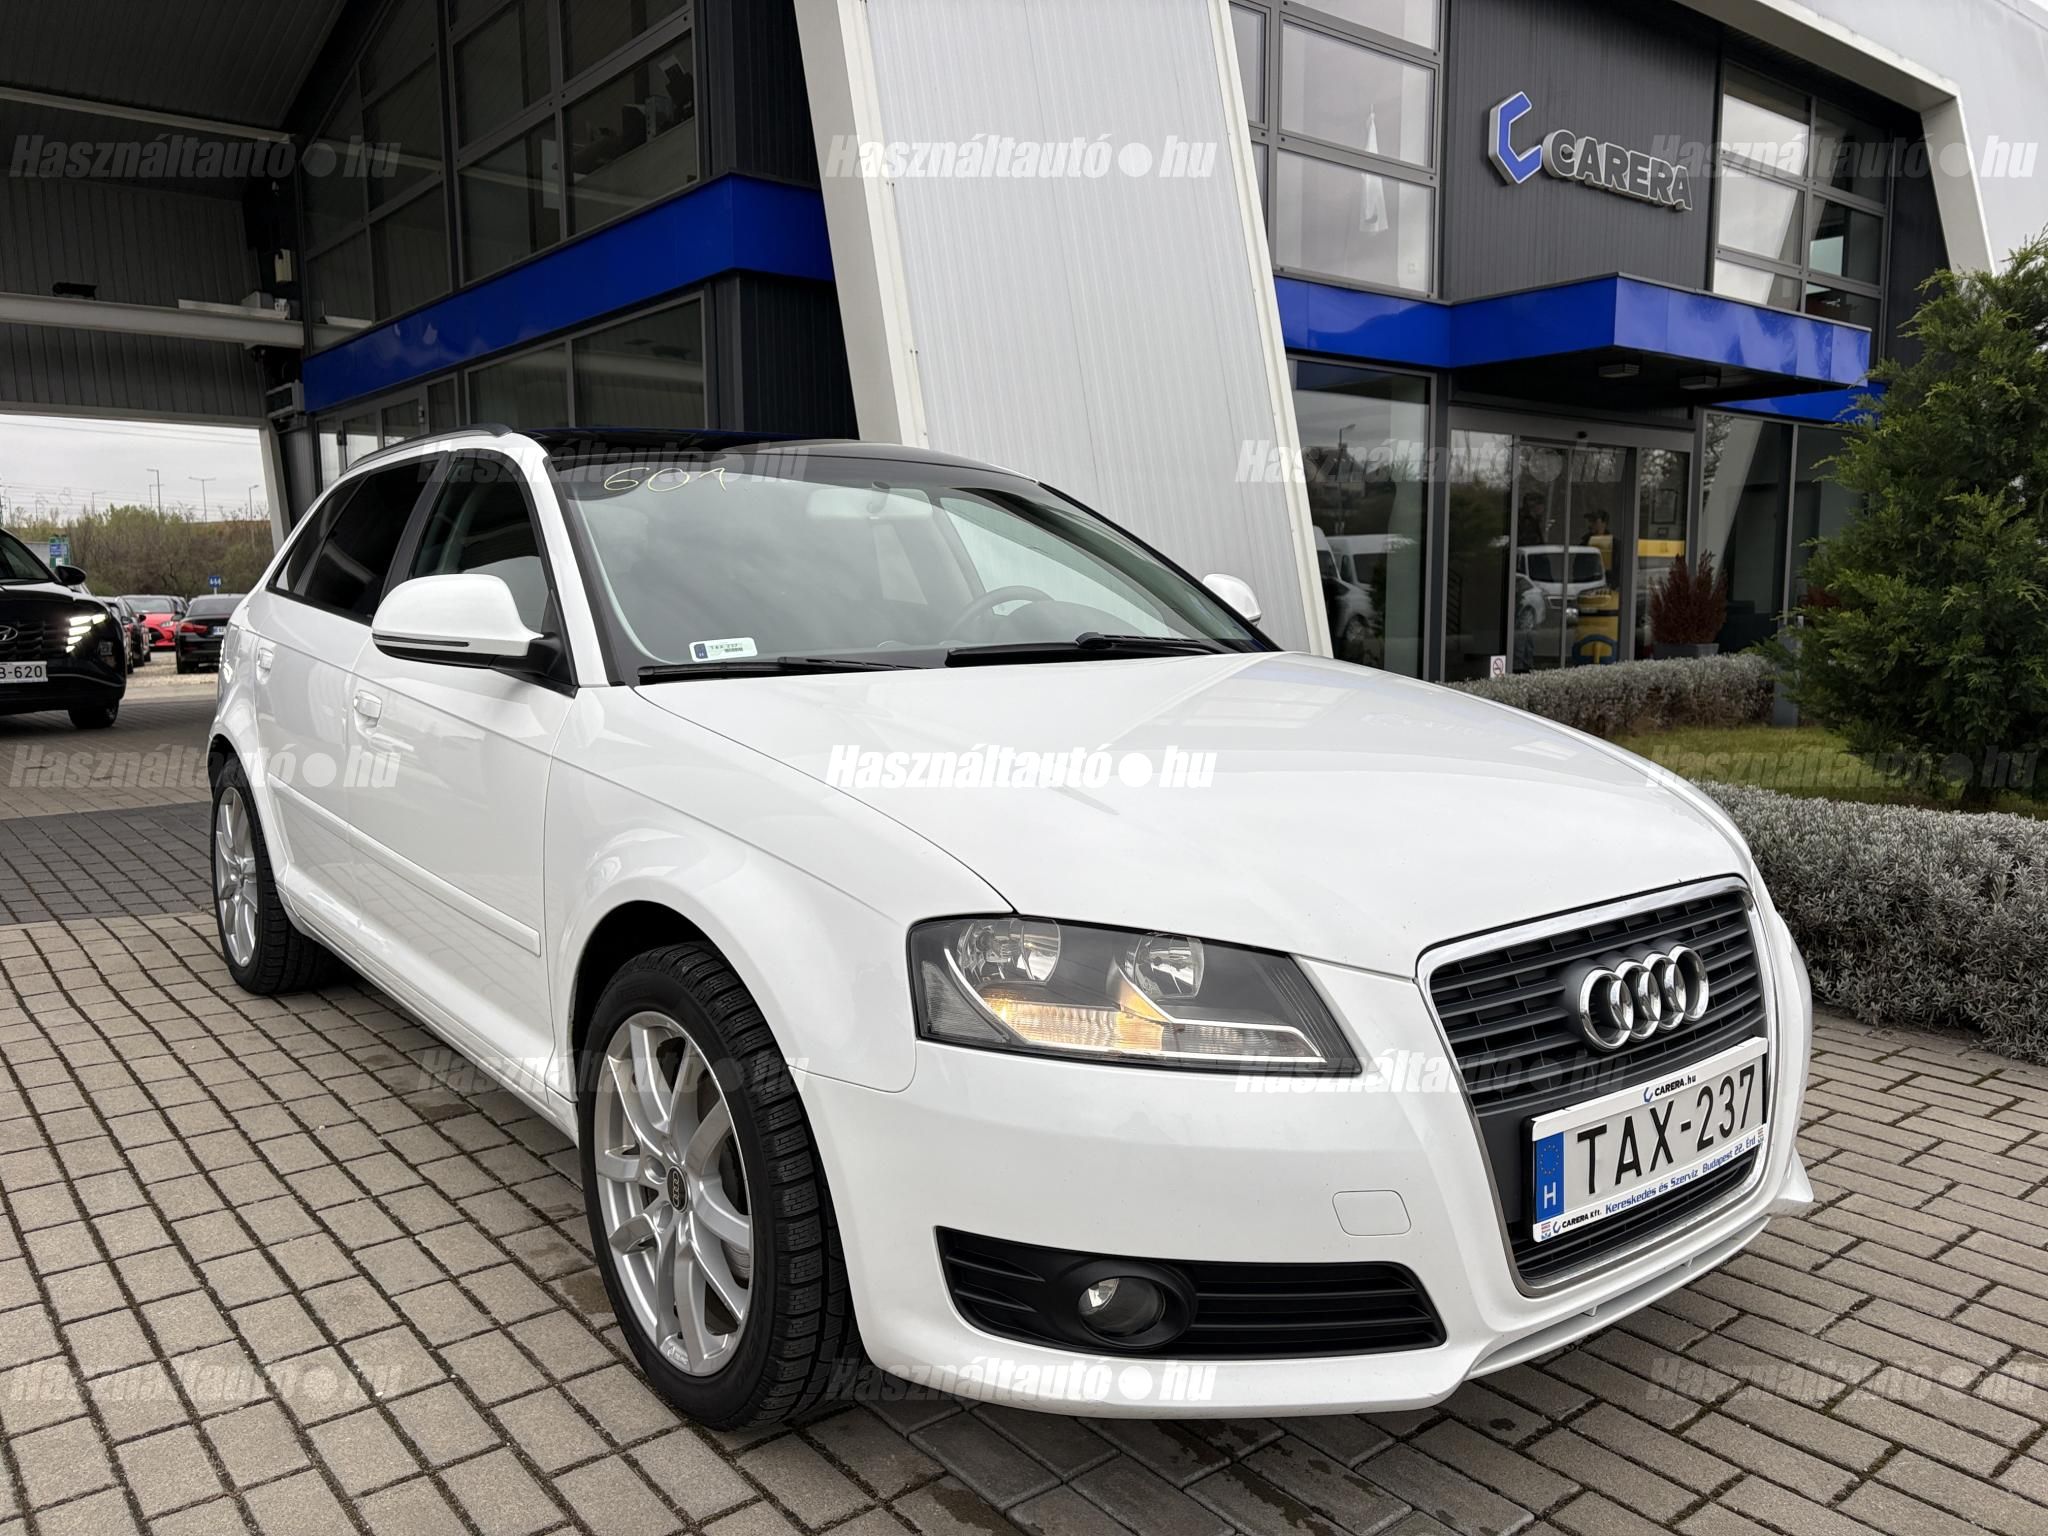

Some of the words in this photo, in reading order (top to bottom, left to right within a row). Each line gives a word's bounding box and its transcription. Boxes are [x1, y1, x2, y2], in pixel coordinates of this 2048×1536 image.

[1546, 129, 1692, 210] CARERA
[1654, 1075, 1697, 1096] CARERA.hu
[1577, 1064, 1755, 1194] TAX-237
[1543, 1182, 1557, 1209] H
[1562, 1214, 1589, 1228] CARERA
